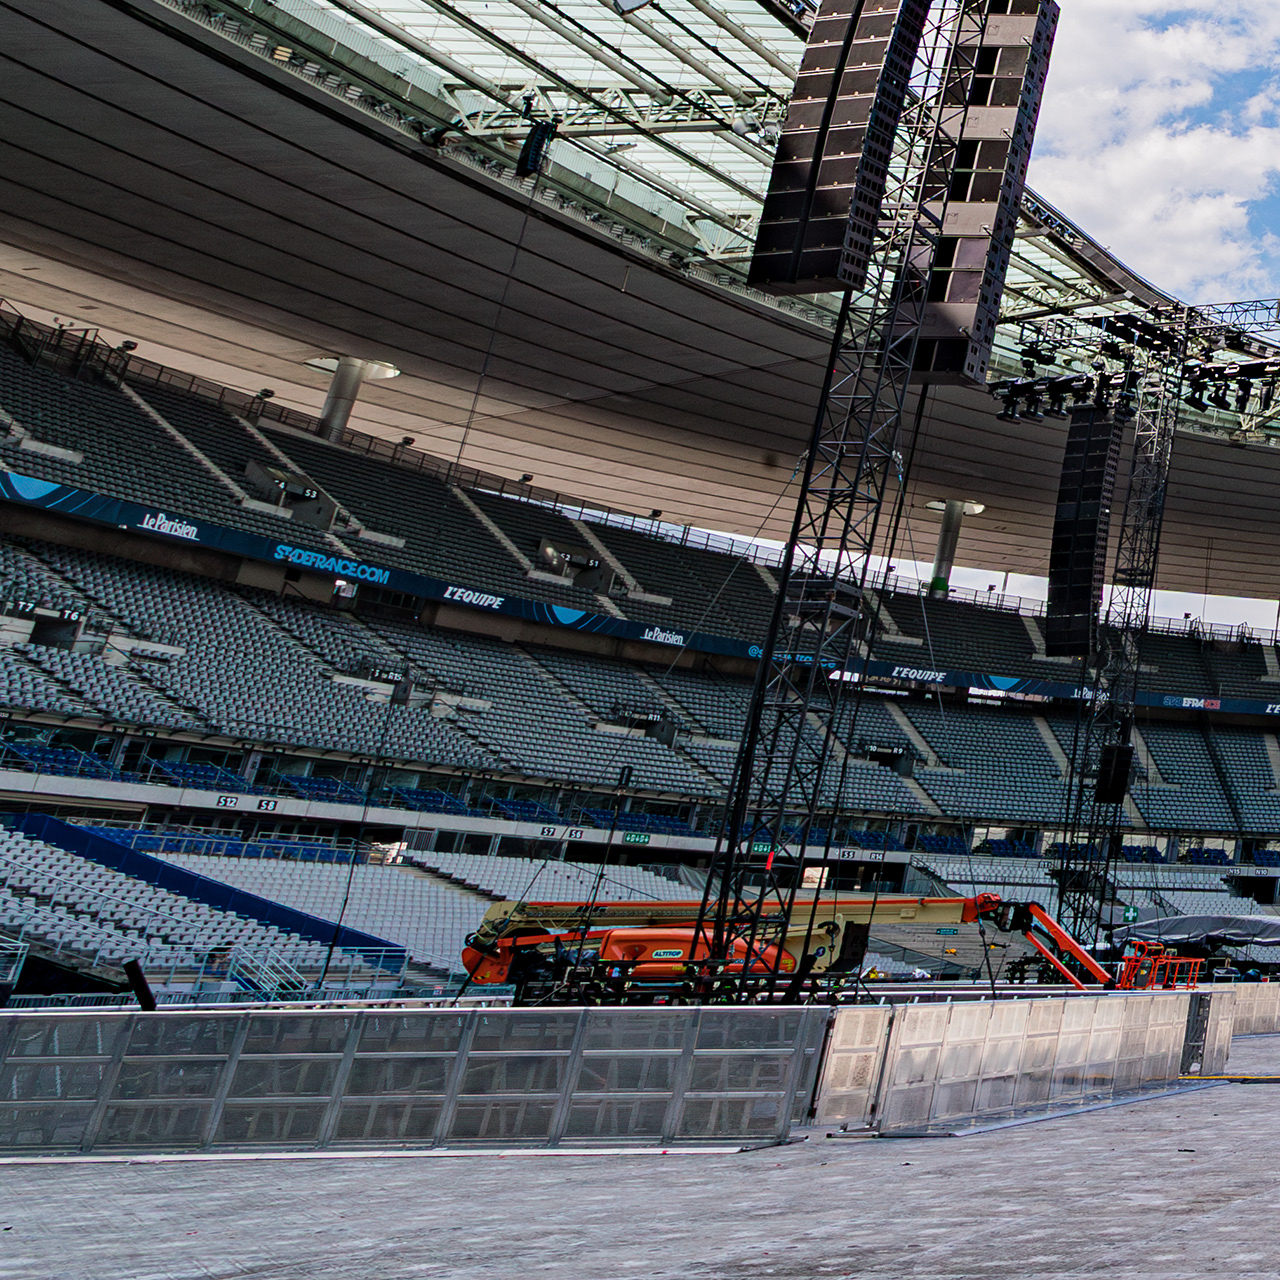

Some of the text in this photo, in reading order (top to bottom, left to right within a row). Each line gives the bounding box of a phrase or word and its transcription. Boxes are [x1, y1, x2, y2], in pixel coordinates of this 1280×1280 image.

[304, 488, 317, 498] S3
[19, 603, 80, 620] T7 T6
[219, 797, 237, 807] S12
[260, 801, 275, 810] S8
[543, 828, 554, 836] S7
[571, 830, 581, 838] S6
